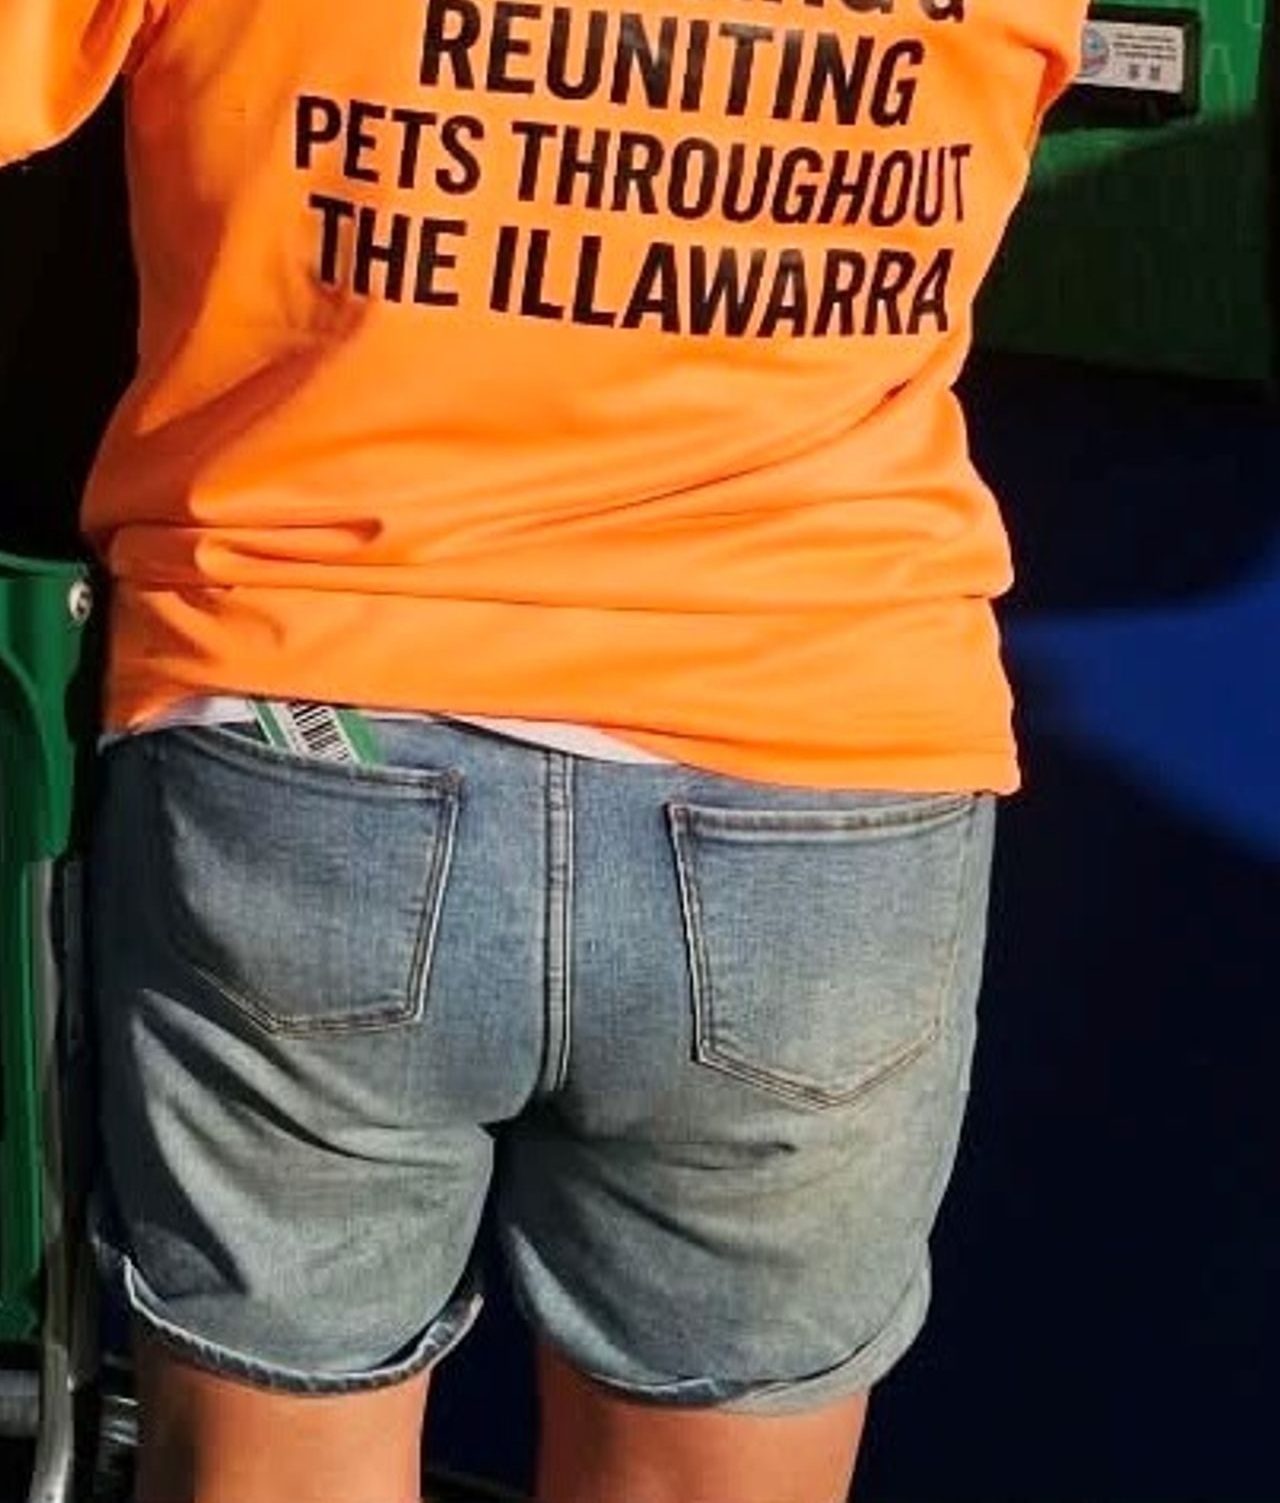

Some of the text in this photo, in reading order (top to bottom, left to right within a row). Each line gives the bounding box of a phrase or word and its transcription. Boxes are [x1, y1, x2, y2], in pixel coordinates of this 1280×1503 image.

[294, 95, 972, 228] PETS THROUGHOUT
[309, 193, 954, 338] THE ILLAWARRA
